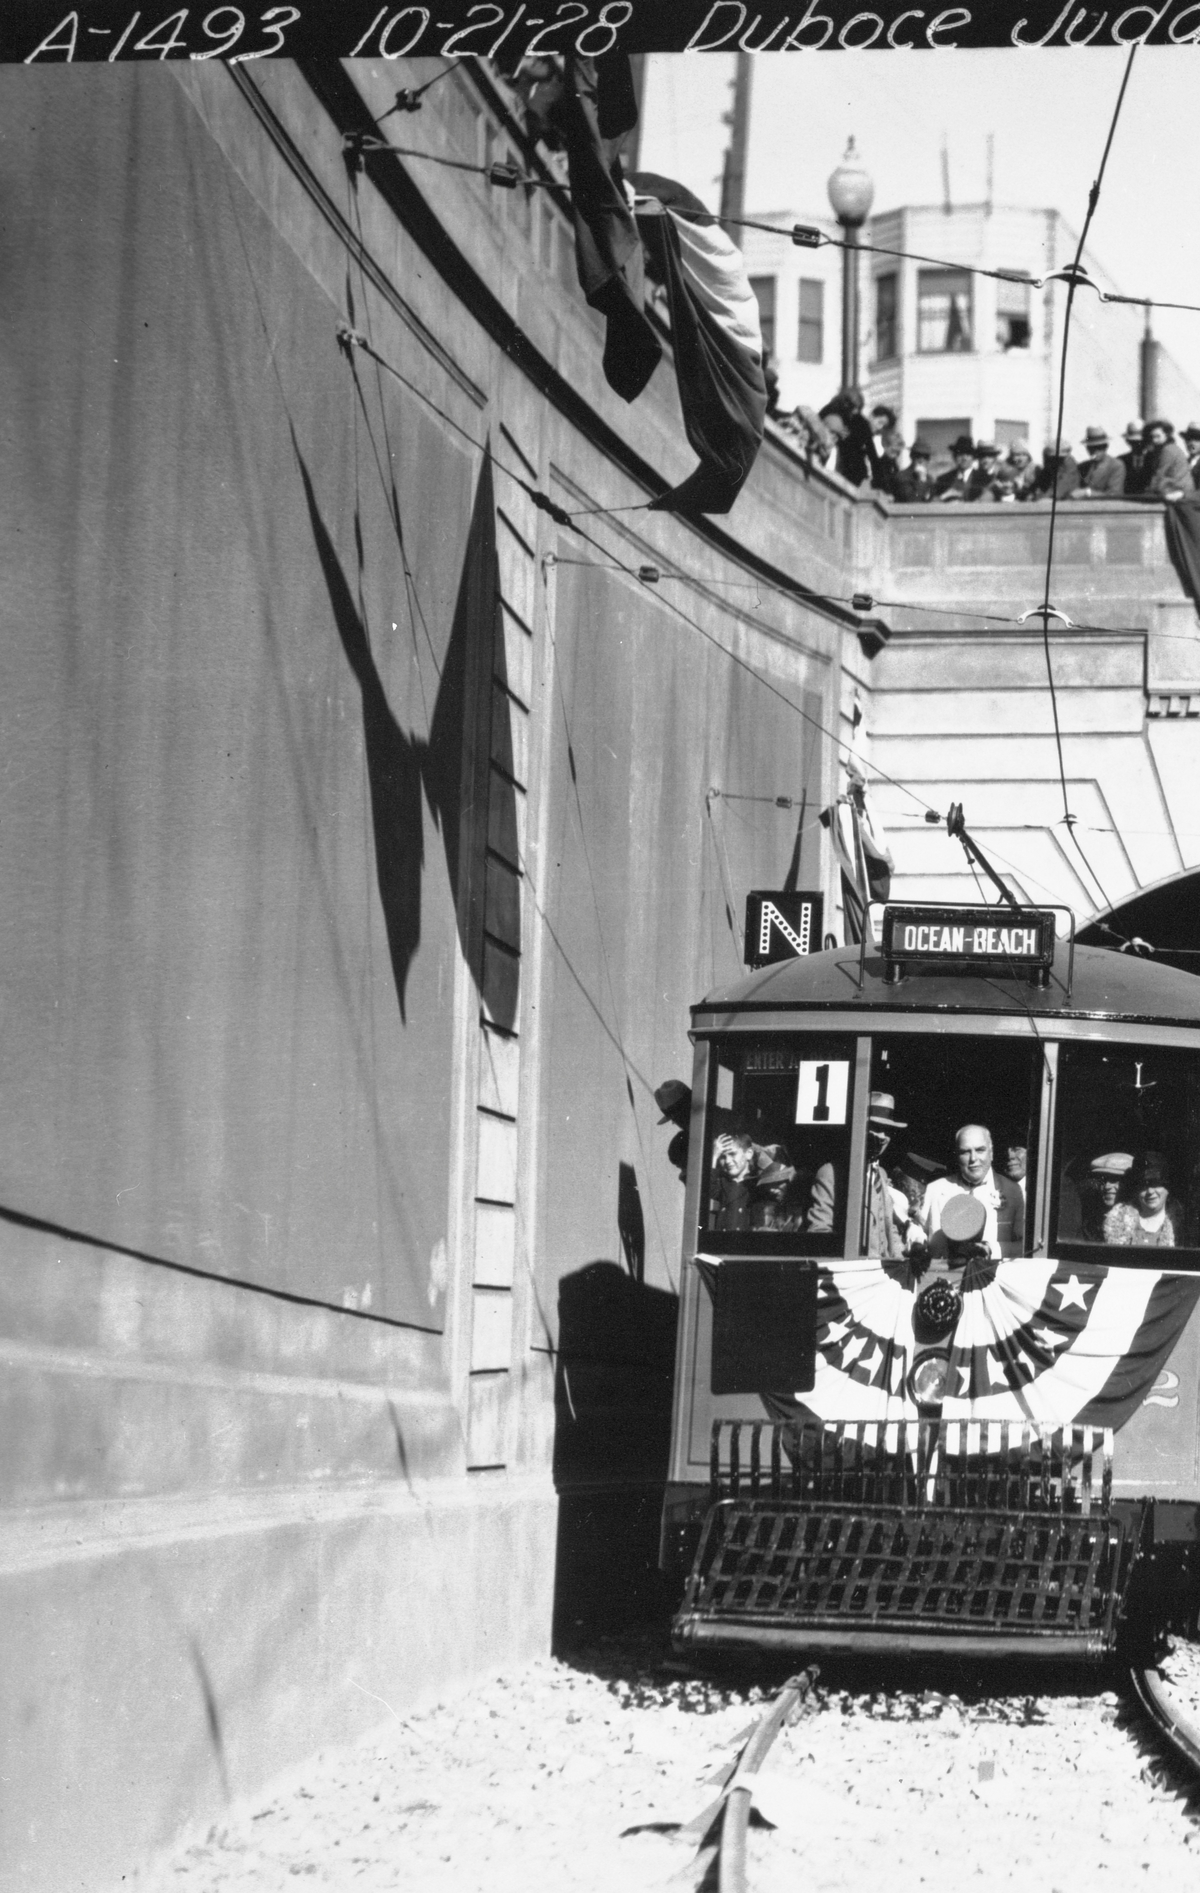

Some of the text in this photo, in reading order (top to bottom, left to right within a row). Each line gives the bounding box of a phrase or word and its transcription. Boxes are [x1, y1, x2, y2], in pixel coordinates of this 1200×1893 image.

[759, 901, 812, 956] N
[904, 925, 1037, 955] OCEAN-BEACH
[812, 1064, 830, 1122] 1
